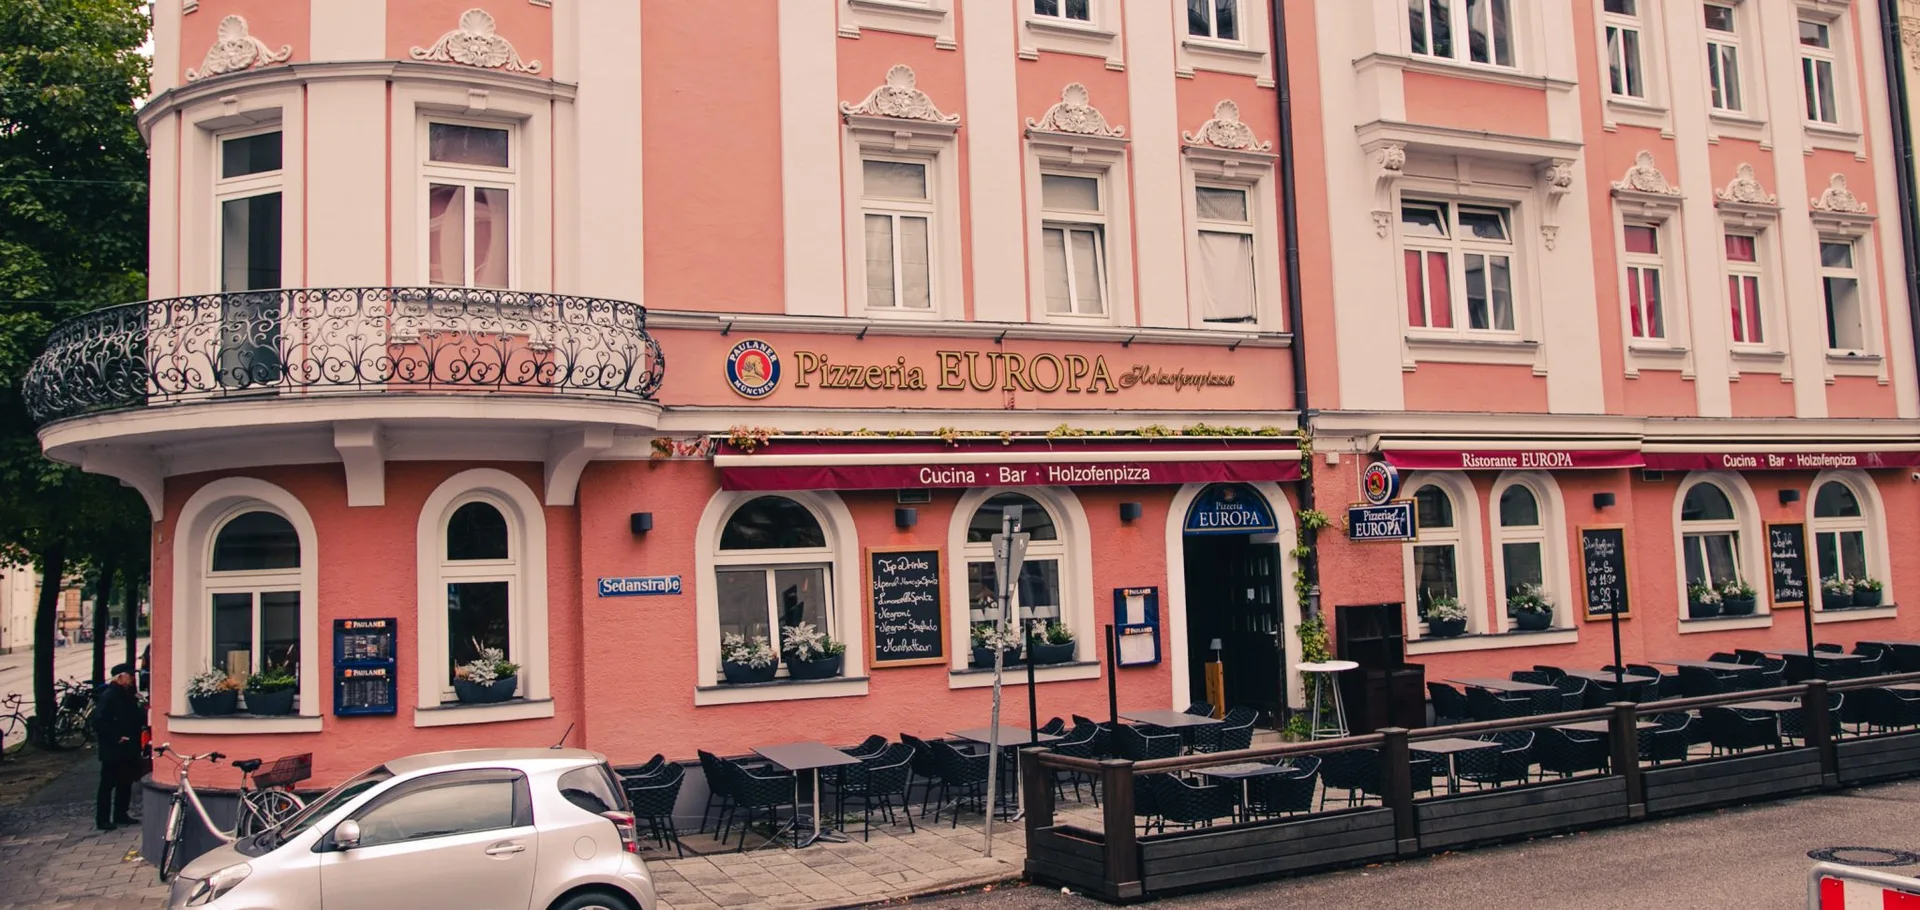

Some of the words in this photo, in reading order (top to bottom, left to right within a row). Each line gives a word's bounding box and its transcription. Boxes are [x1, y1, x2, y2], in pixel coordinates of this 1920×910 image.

[730, 341, 778, 362] PAULANER
[794, 351, 927, 391] Pizzeria
[936, 350, 1119, 393] EUROPA
[1119, 364, 1236, 392] Holzofenpizza
[734, 380, 775, 395] MÜNCHEN
[1461, 453, 1518, 467] Ristorante
[1521, 452, 1574, 467] EUROPA
[1723, 454, 1757, 467] Cucina
[1768, 454, 1785, 467] Bar
[1797, 453, 1857, 468] Holzofenpizza
[919, 467, 976, 484] Cucina
[999, 467, 1027, 483] Bar
[1049, 465, 1151, 484] Holzofenpizza
[1215, 501, 1243, 510] Pizzeria
[1199, 511, 1261, 526] EUROPA
[1363, 510, 1394, 521] Pizzeria
[1355, 521, 1402, 537] EUROPA
[897, 556, 929, 570] Drinks
[603, 578, 680, 593] Sedanstraße
[353, 620, 386, 629] PAULANER
[1130, 626, 1153, 634] PAULANER
[353, 668, 386, 677] PAULANER
